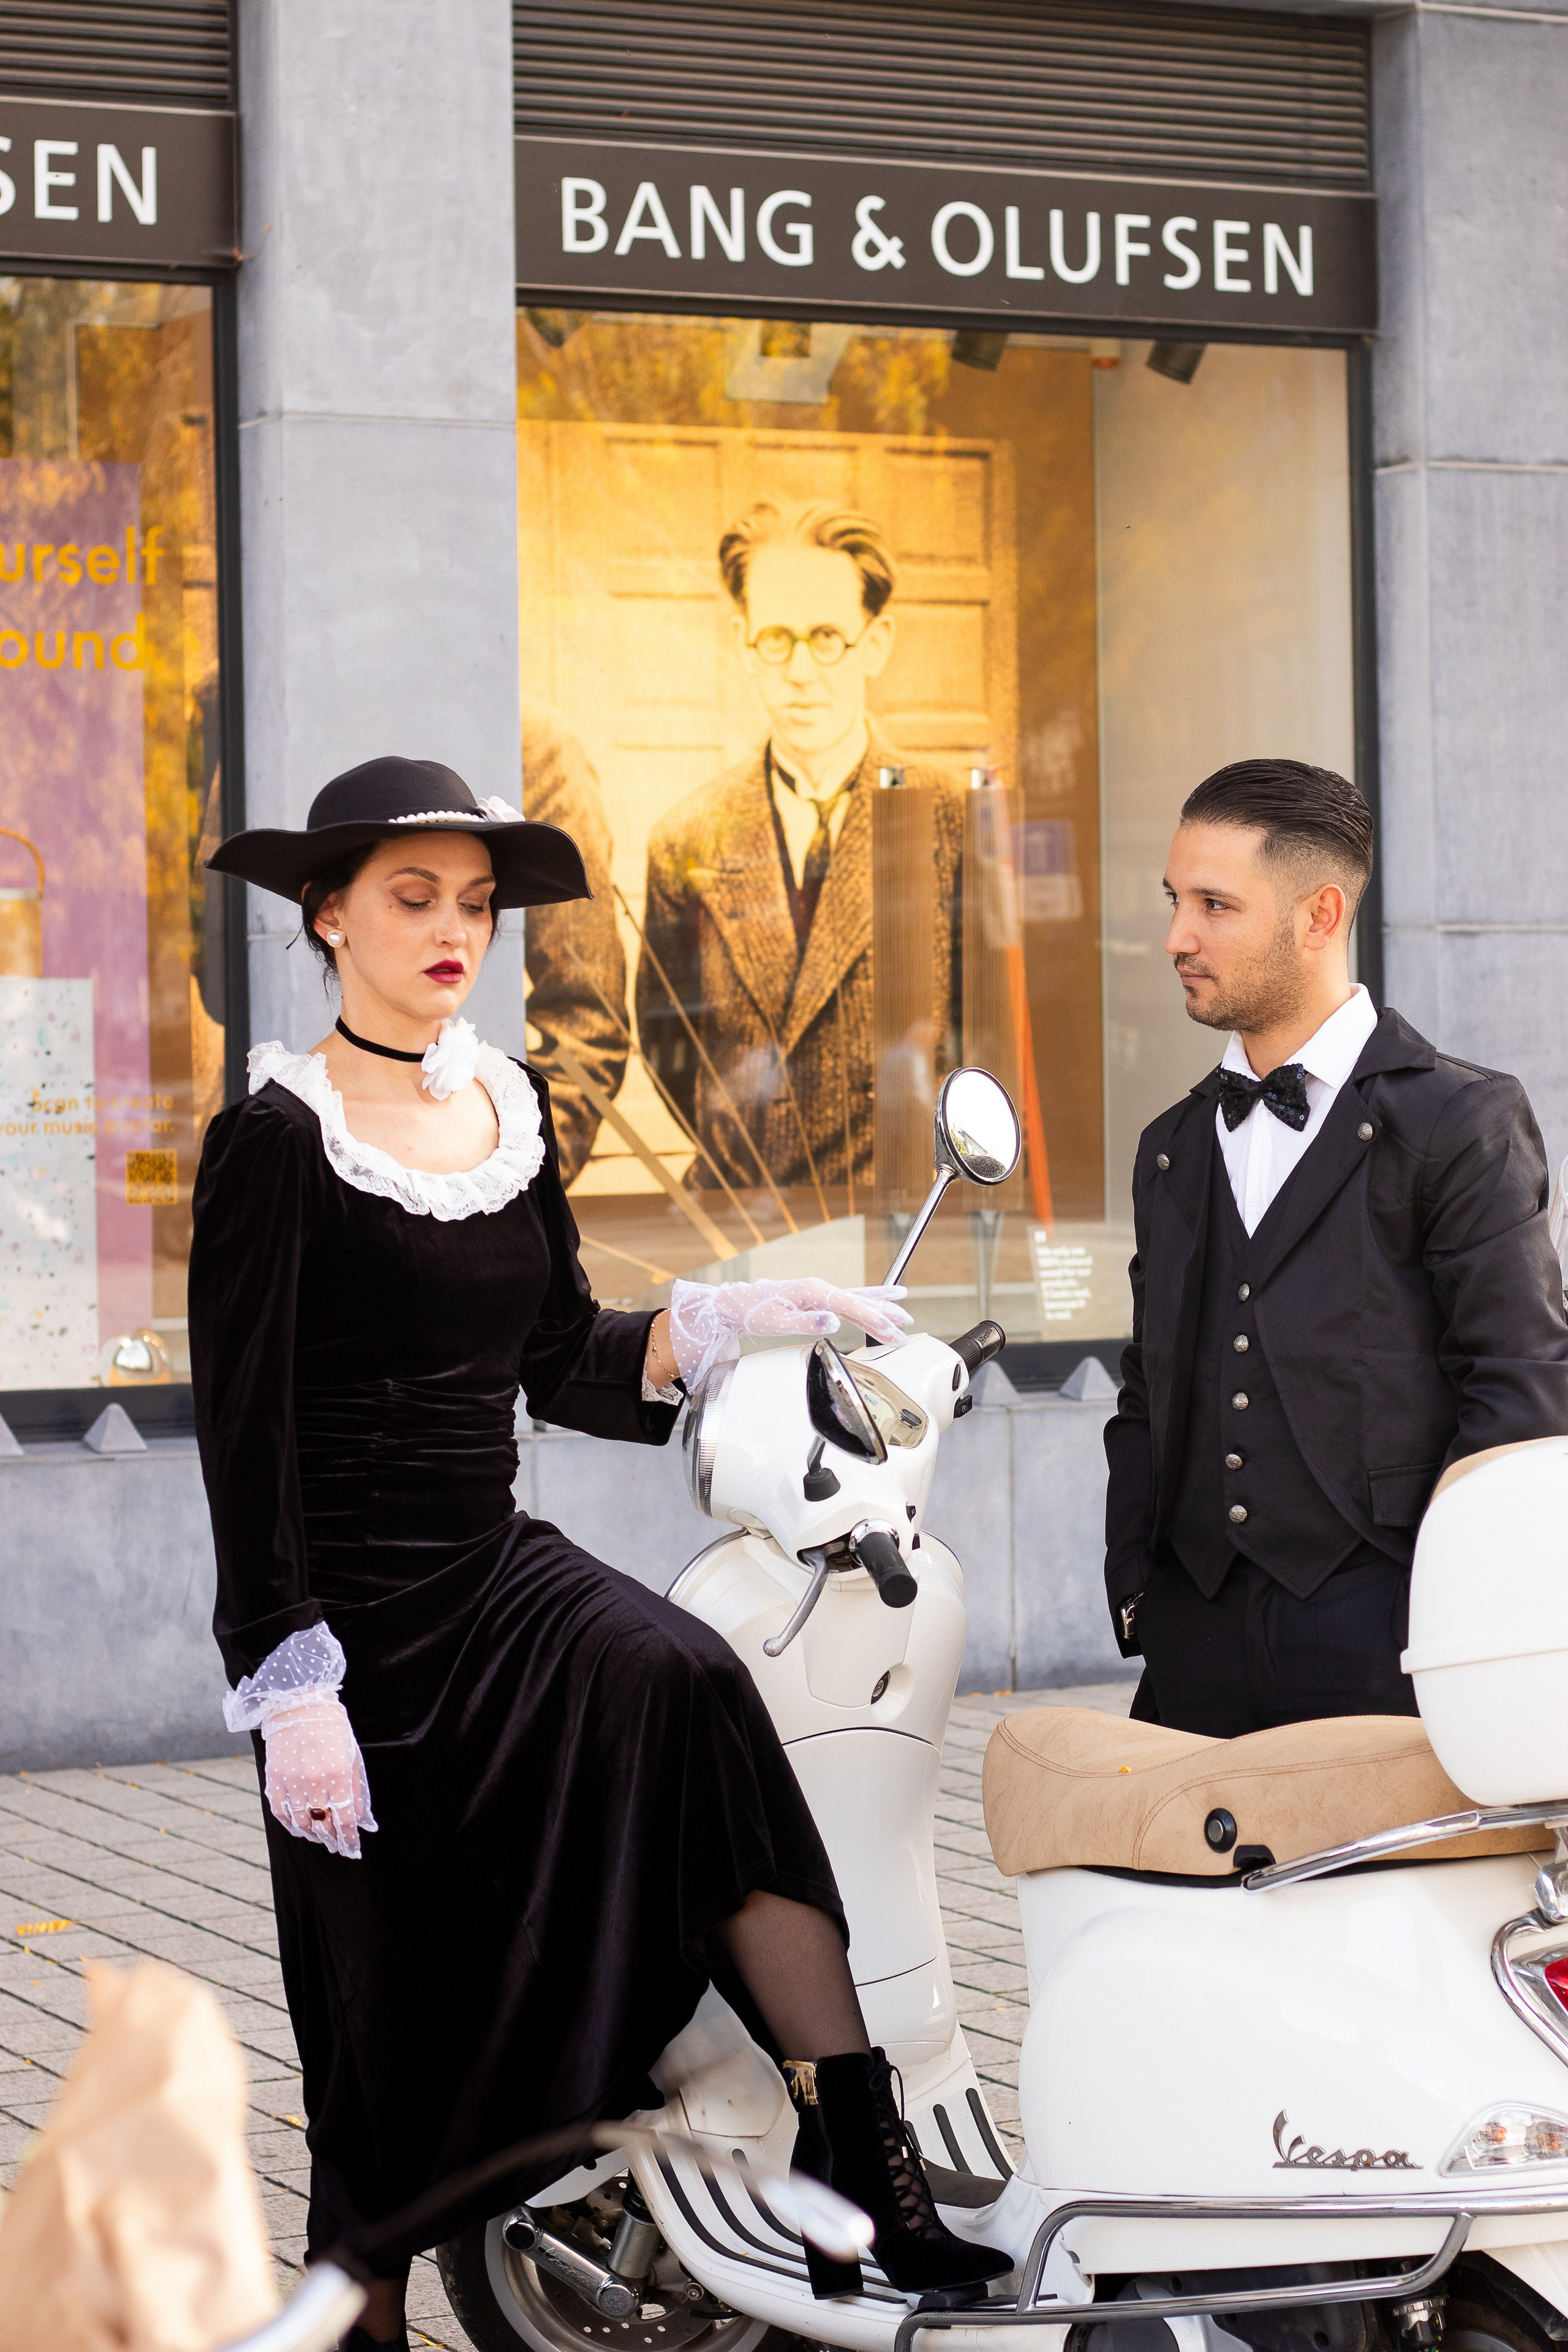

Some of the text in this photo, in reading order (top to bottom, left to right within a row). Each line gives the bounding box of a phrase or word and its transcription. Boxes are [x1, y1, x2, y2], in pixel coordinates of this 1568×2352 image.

[560, 176, 1314, 296] BANG & OLUFSEN
[86, 1095, 105, 1111] to
[0, 1122, 37, 1137] our
[43, 1117, 97, 1136] music
[1272, 2109, 1424, 2171] Vespa
